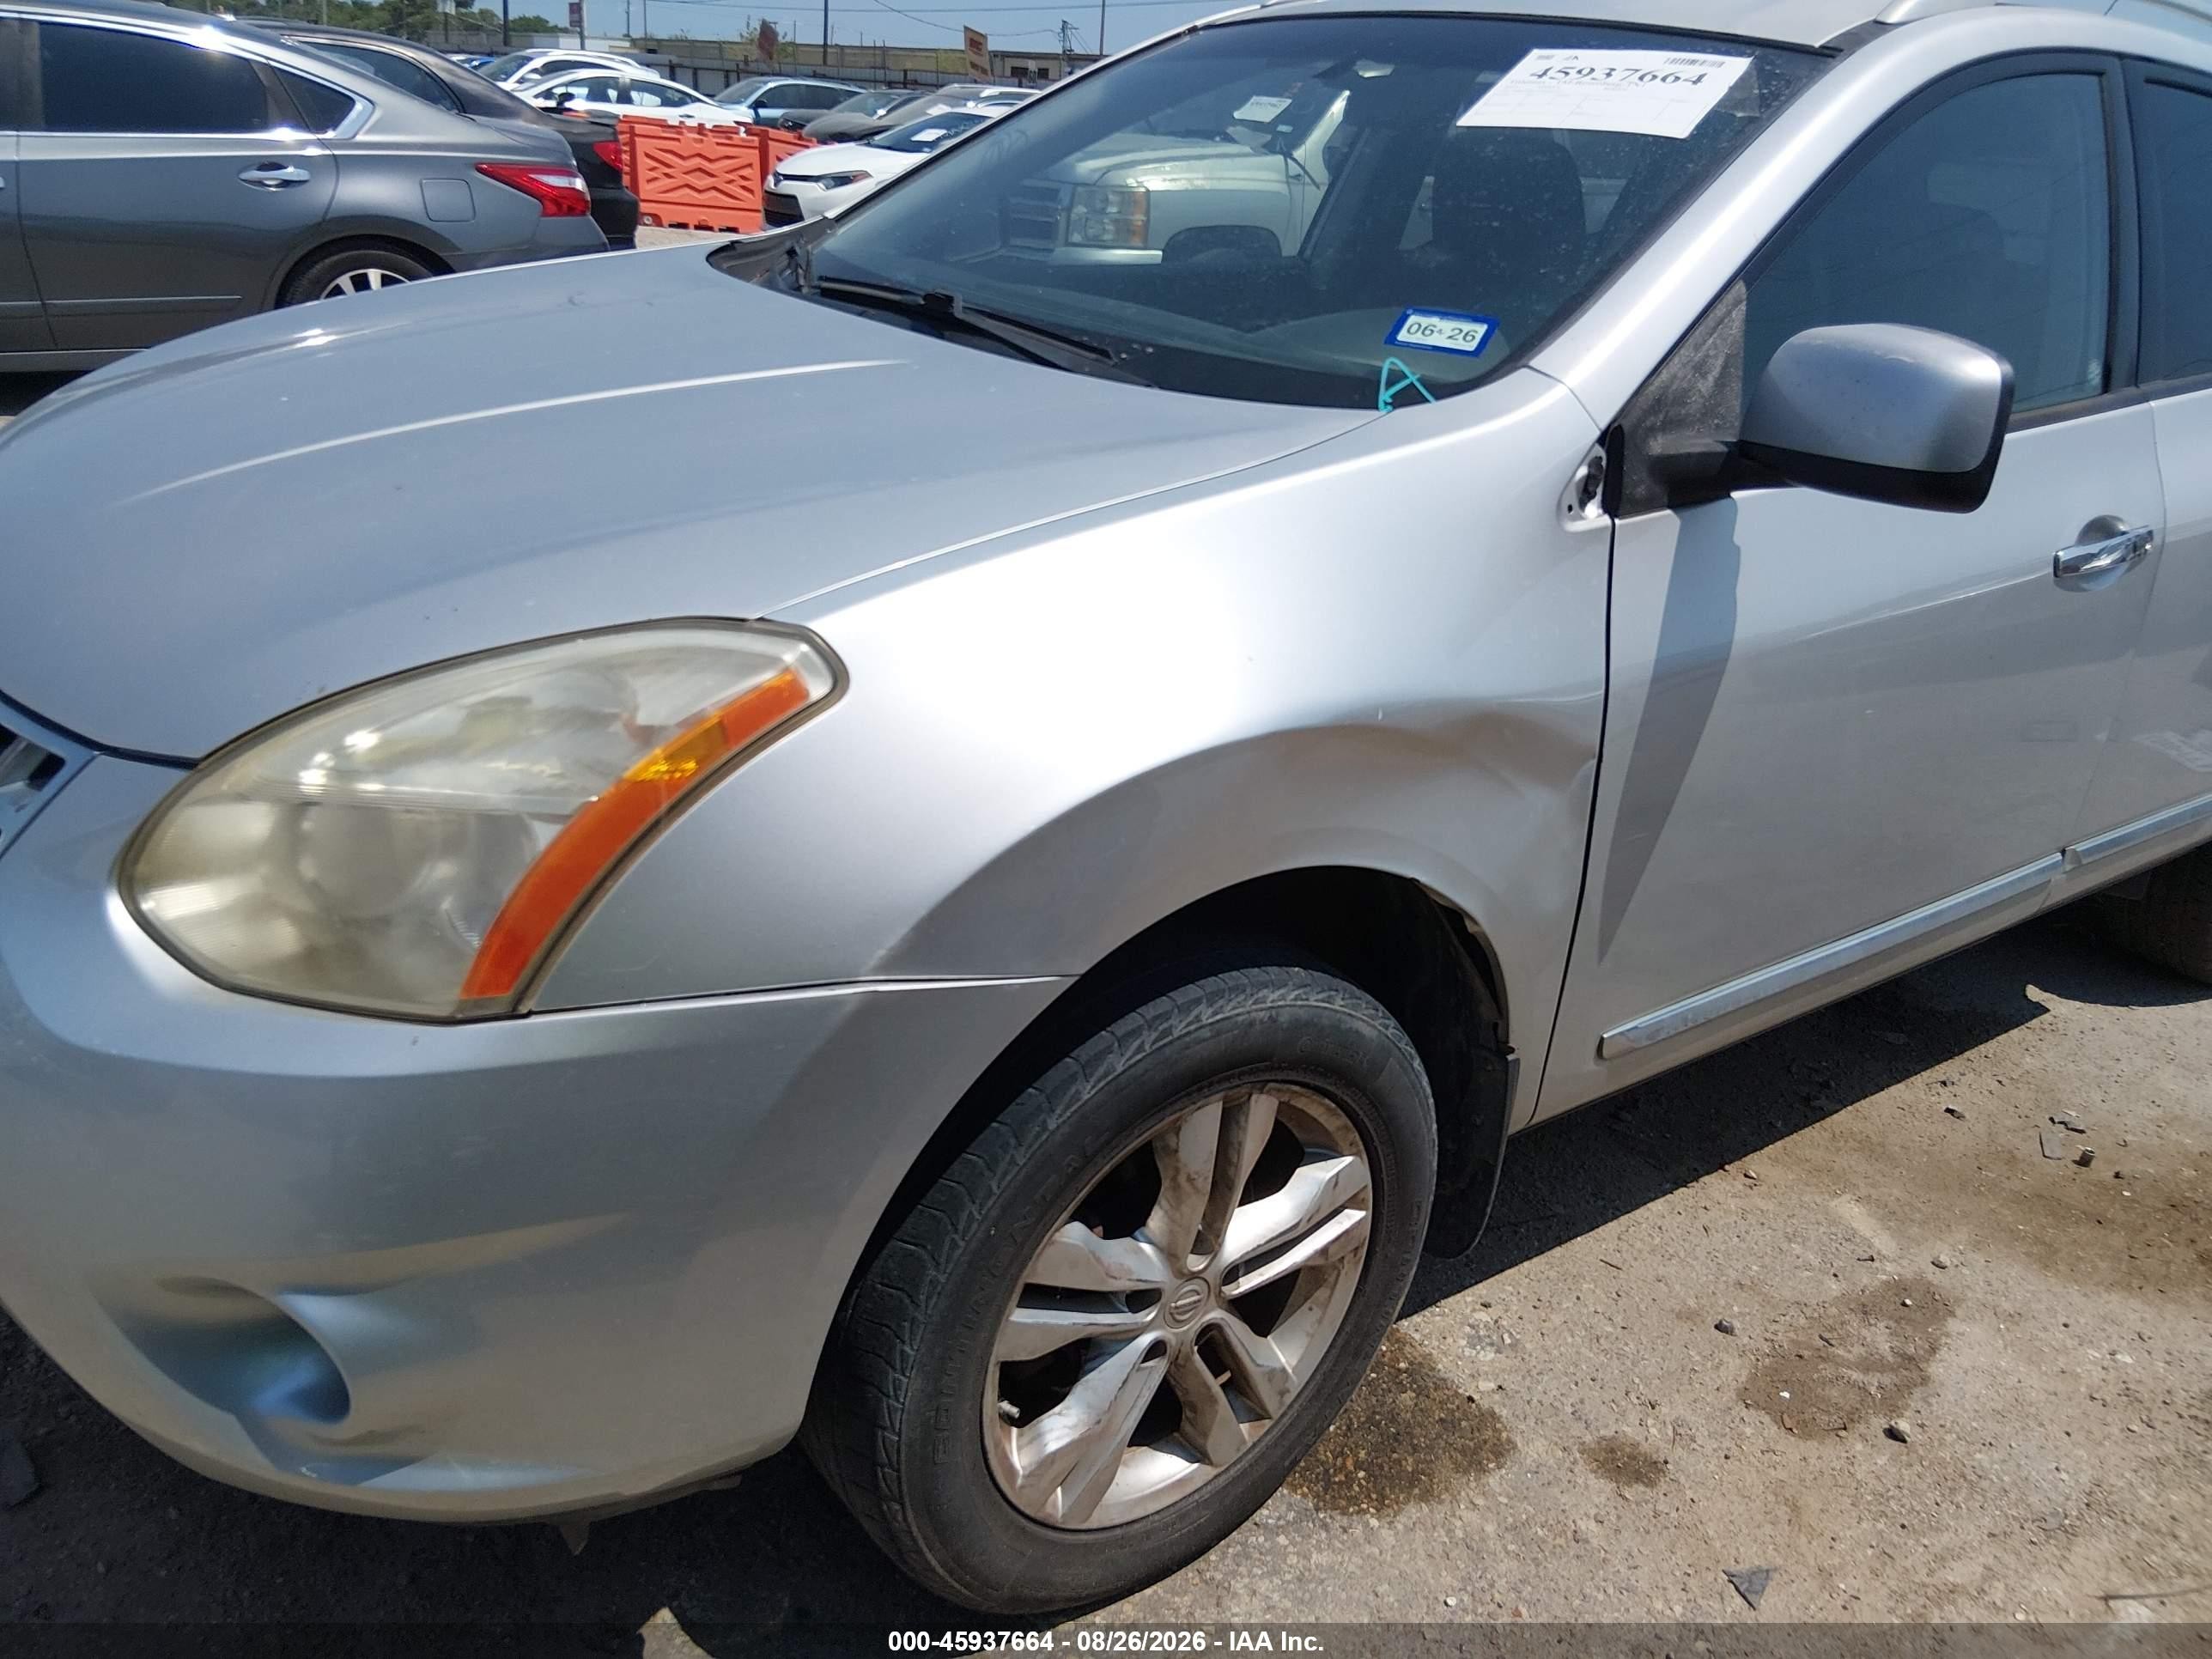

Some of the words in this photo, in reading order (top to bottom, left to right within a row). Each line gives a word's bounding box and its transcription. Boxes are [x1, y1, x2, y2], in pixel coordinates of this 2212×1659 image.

[1529, 65, 1708, 86] 45937664
[1407, 322, 1437, 337] 06
[1446, 327, 1479, 343] 26
